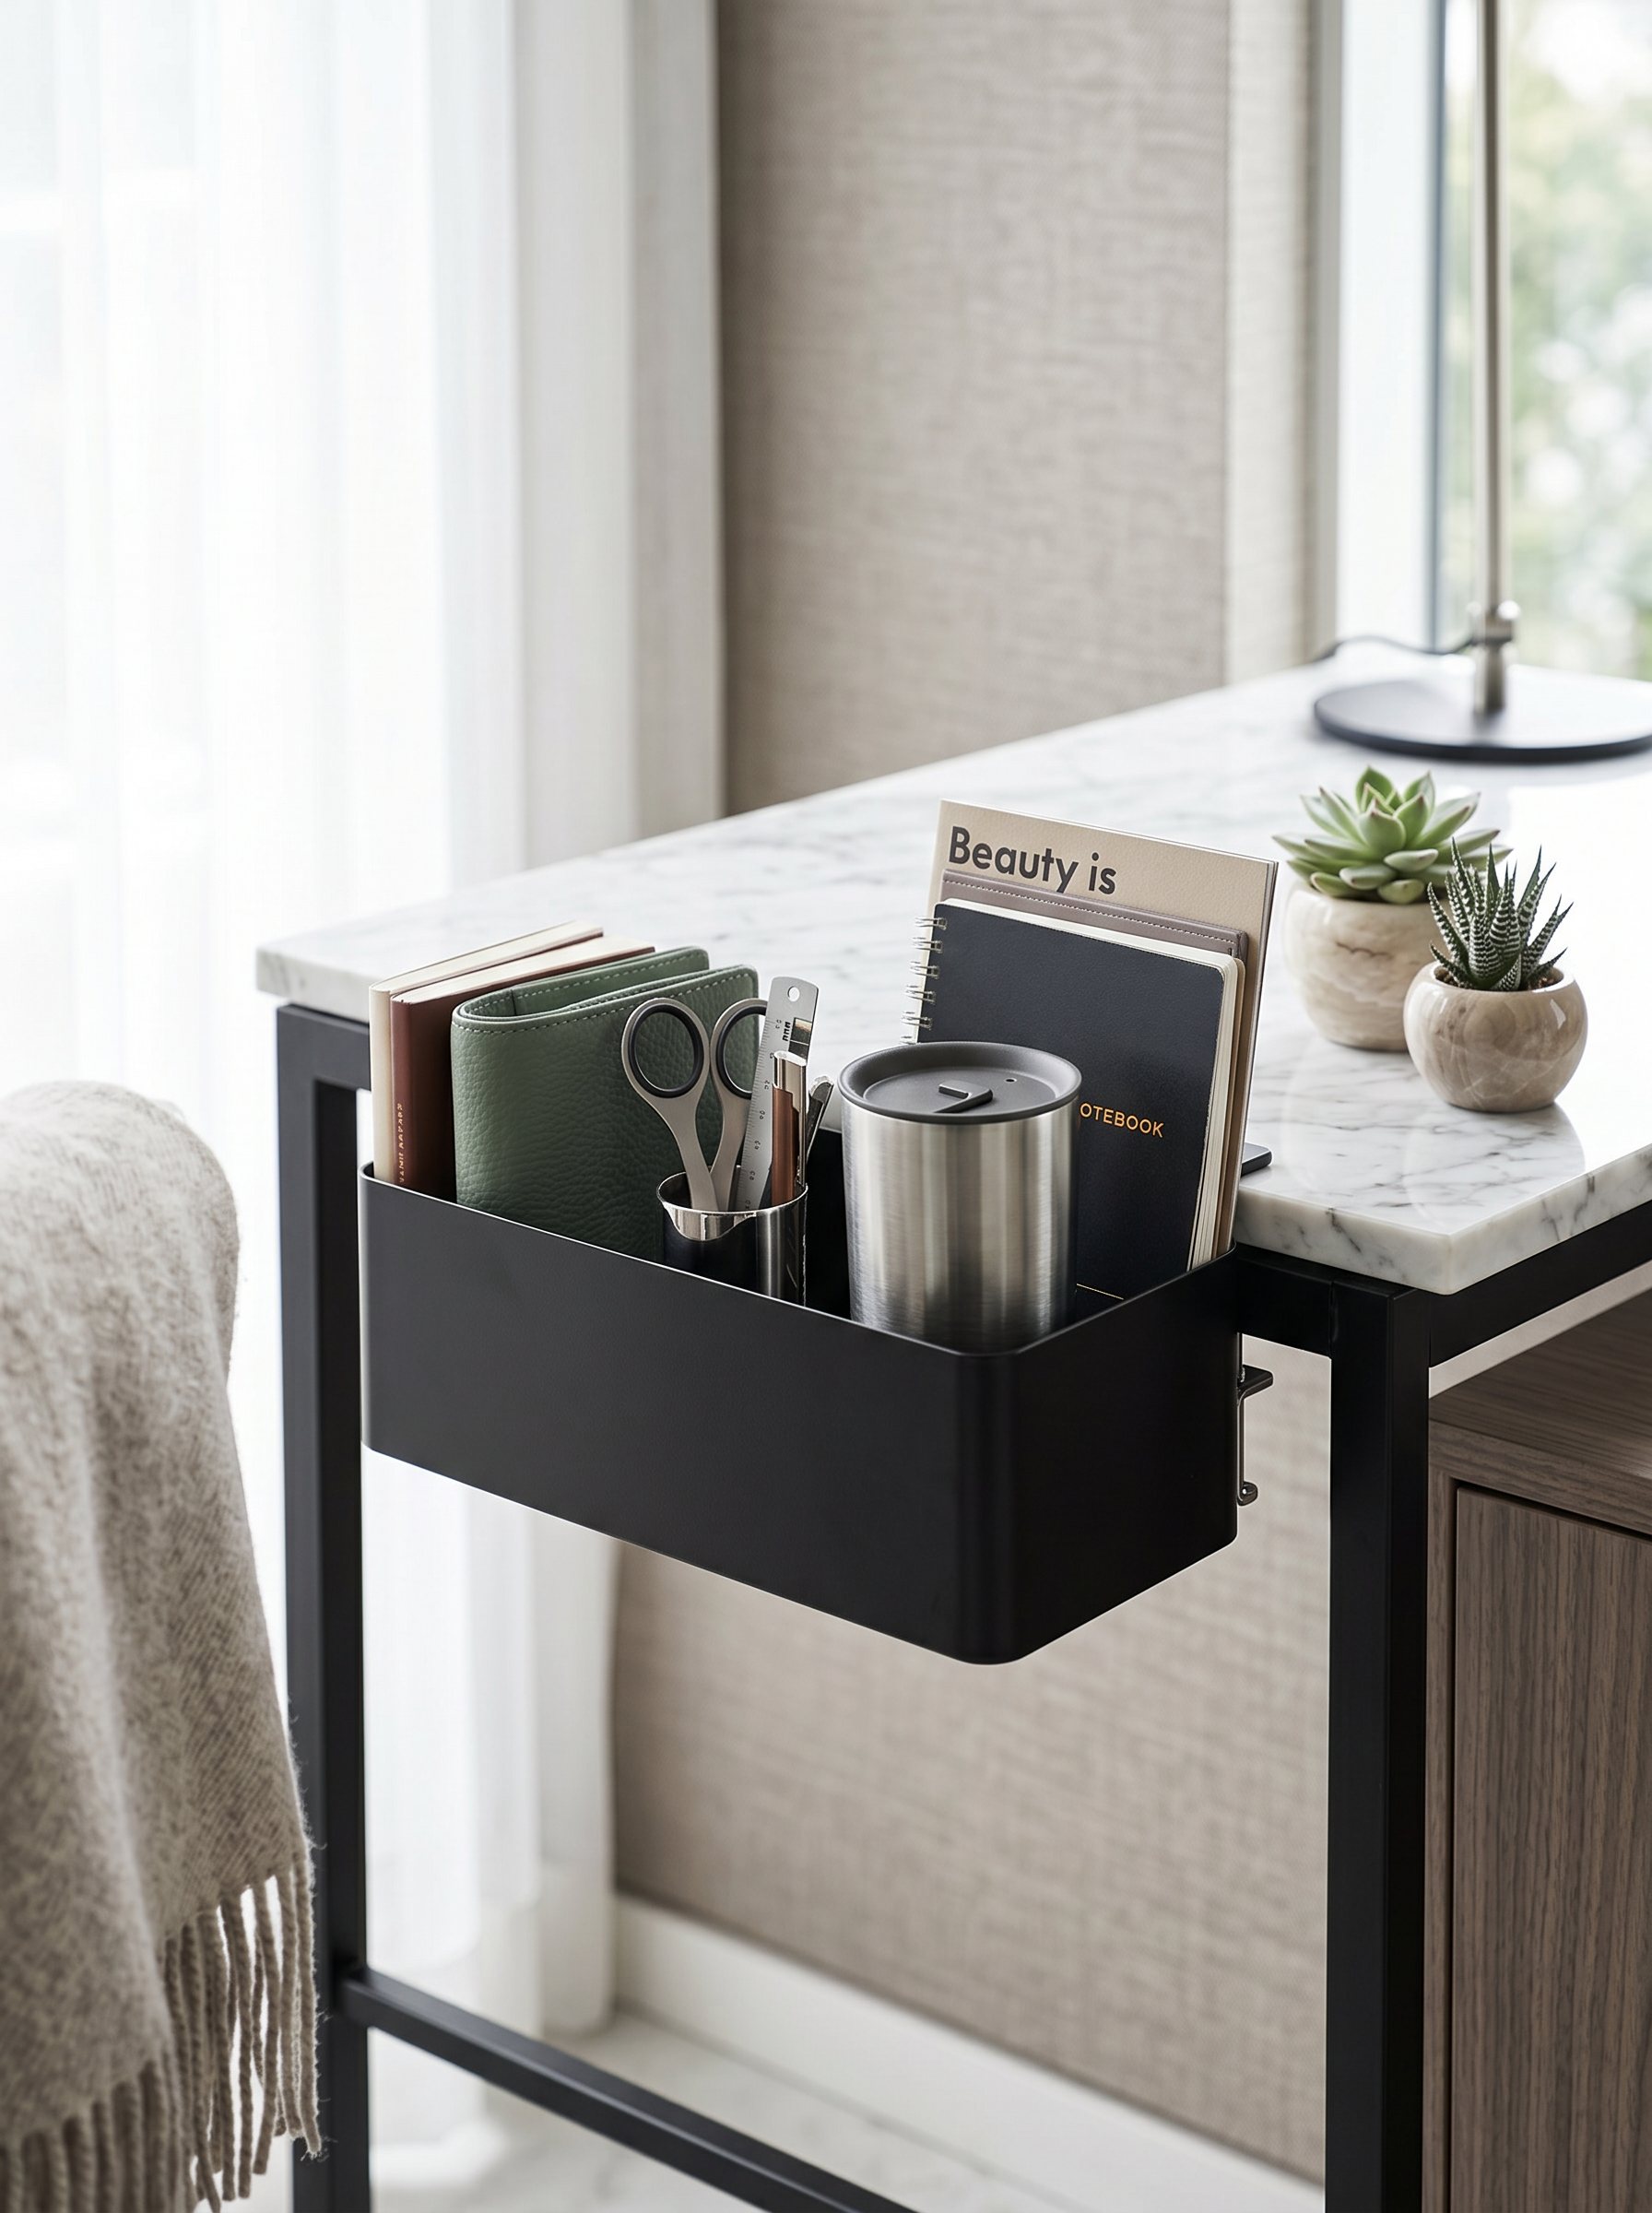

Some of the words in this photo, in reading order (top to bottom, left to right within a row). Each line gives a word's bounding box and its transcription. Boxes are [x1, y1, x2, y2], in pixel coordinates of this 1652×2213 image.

[949, 825, 1079, 893] Beauty
[1088, 852, 1116, 895] is
[1080, 1102, 1164, 1139] OTEBOOK
